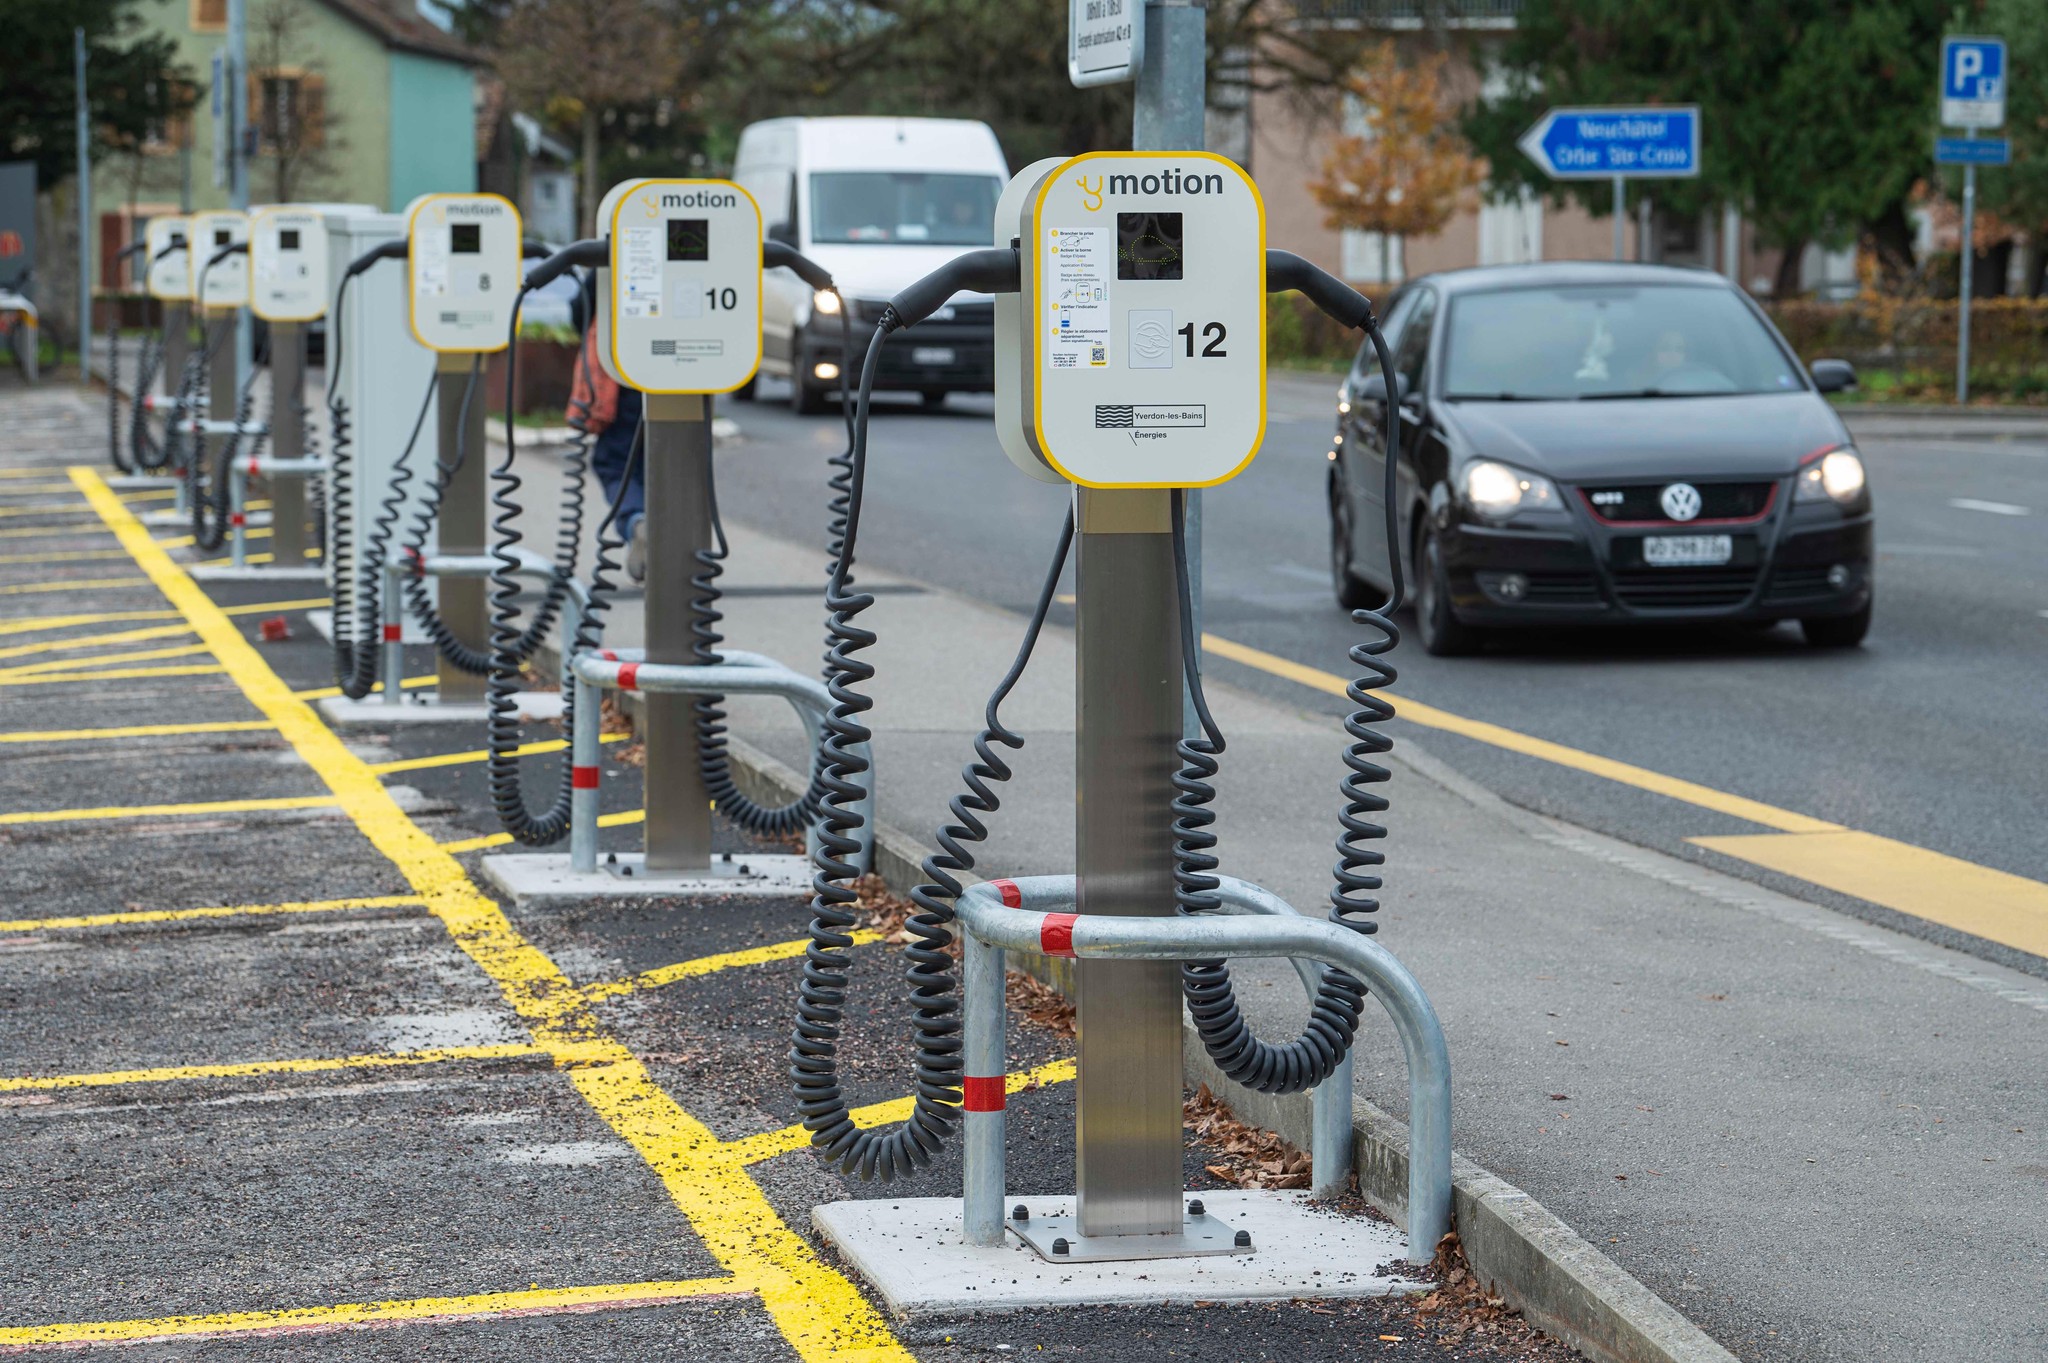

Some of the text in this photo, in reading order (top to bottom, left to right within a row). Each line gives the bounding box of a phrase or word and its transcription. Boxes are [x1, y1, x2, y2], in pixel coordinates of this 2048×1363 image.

[1954, 48, 1983, 91] P
[1109, 168, 1223, 195] motion
[662, 191, 736, 208] motion
[479, 273, 491, 291] 8
[706, 287, 737, 310] 10
[1178, 321, 1227, 358] 12
[1134, 412, 1203, 420] Yverdon-les-Bains
[1134, 430, 1167, 440] Énergies
